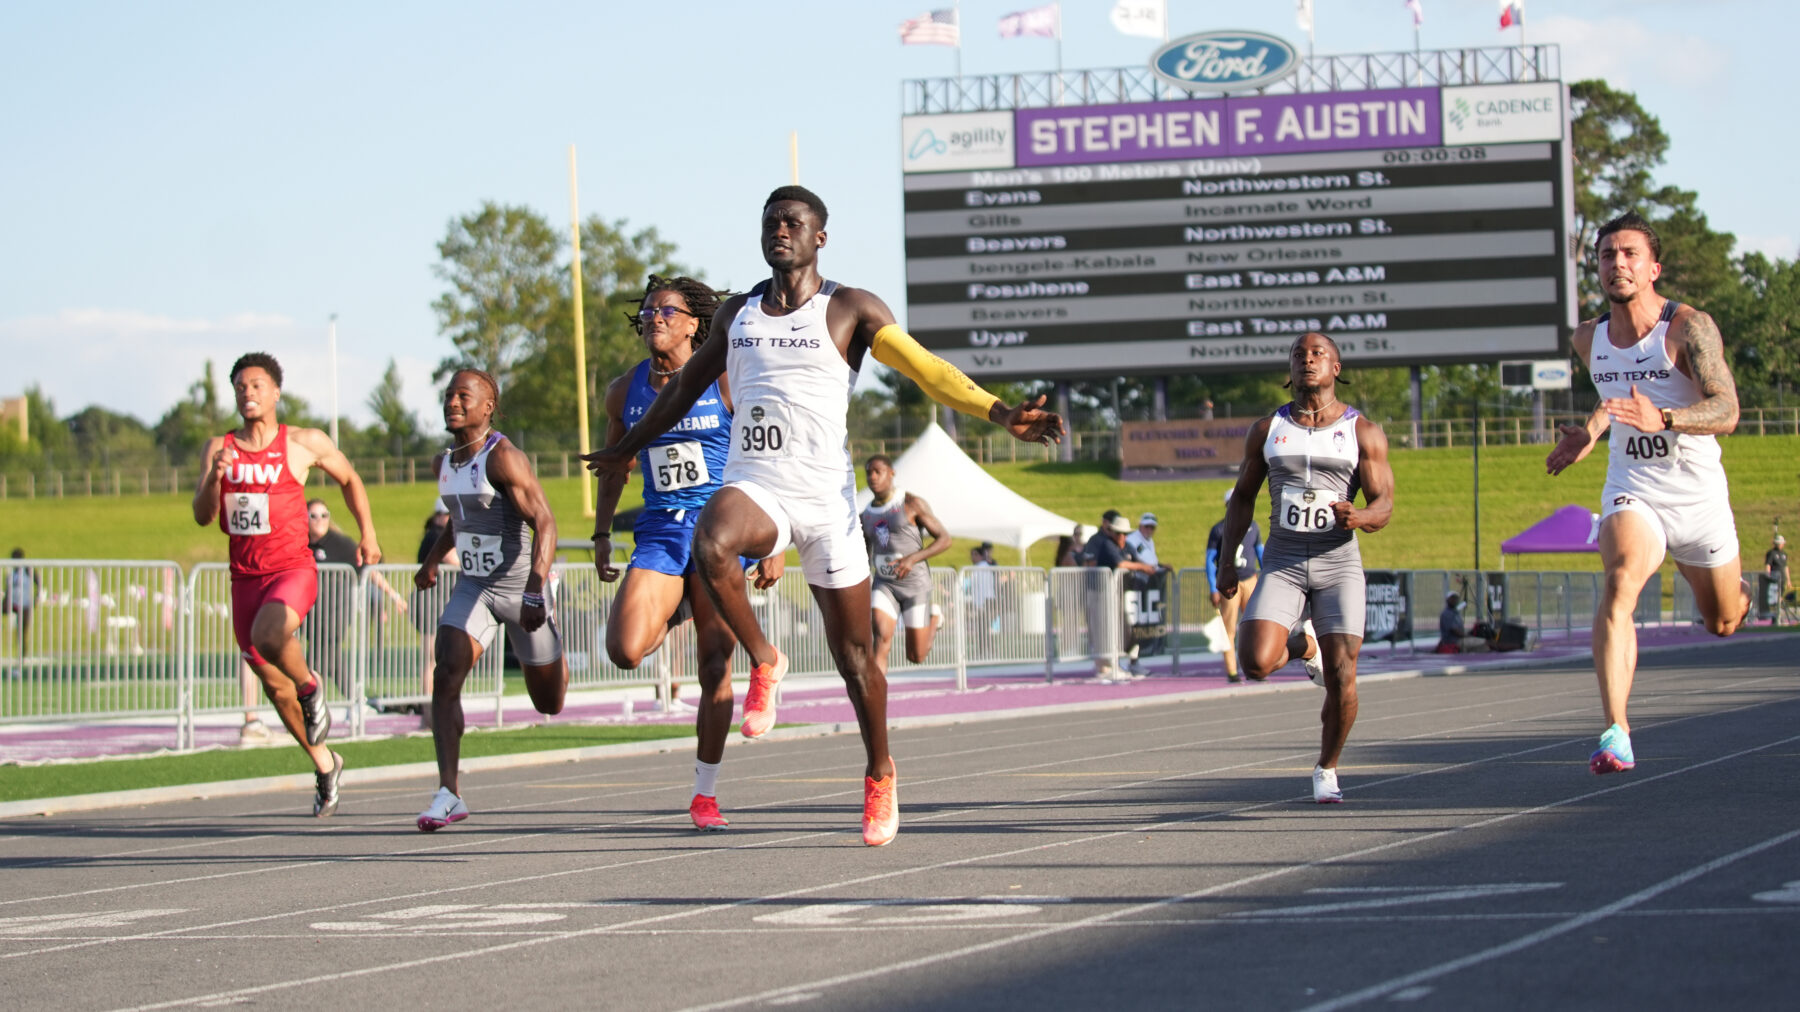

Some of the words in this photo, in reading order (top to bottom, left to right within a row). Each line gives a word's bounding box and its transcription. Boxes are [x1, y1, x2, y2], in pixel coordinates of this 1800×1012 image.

[1176, 39, 1268, 79] Ford
[1476, 96, 1553, 116] CADENCE
[951, 127, 1006, 146] agility
[1031, 110, 1220, 154] STEPHEN
[1235, 108, 1264, 144] F.
[1275, 100, 1426, 142] AUSTIN
[1383, 146, 1487, 164] 00:00:08
[972, 170, 1043, 187] Men's
[1051, 167, 1092, 182] 100
[1100, 163, 1180, 180] Meters
[1191, 157, 1262, 178] (Univ)
[966, 189, 1041, 206] Evans
[1183, 172, 1350, 194] Northwestern
[1357, 171, 1391, 186] St.
[968, 213, 1021, 228] Gills
[1185, 199, 1299, 217] Incarnate
[1306, 196, 1373, 211] Word
[967, 235, 1067, 253] Beavers
[1185, 220, 1351, 242] Northwestern
[1359, 218, 1392, 234] St.
[1187, 251, 1239, 264] New
[1247, 247, 1342, 261] Orleans
[968, 281, 1089, 298] Fosuhene
[1186, 273, 1242, 289] East
[1249, 270, 1320, 286] Texas
[1326, 265, 1386, 283] A&M
[971, 306, 1068, 321] Beavers
[1189, 293, 1354, 312] Northwestern
[1362, 291, 1395, 304] St.
[732, 337, 763, 349] EAST
[769, 337, 820, 349] TEXAS
[969, 330, 1028, 347] Uyar
[1187, 320, 1244, 337] East
[1251, 316, 1321, 333] Texas
[1327, 313, 1387, 330] A&M
[972, 354, 1003, 367] Vu
[1190, 341, 1355, 359] Northwen
[1364, 338, 1396, 351] St.
[1593, 371, 1620, 384] EAST
[1623, 369, 1670, 382] TEXAS
[668, 414, 720, 433] LEANS
[741, 424, 783, 452] 390
[1625, 435, 1669, 460] 409
[225, 463, 283, 484] UIW
[658, 460, 699, 487] 578
[231, 510, 261, 530] 454
[1286, 504, 1329, 529] 616
[461, 550, 496, 572] 615
